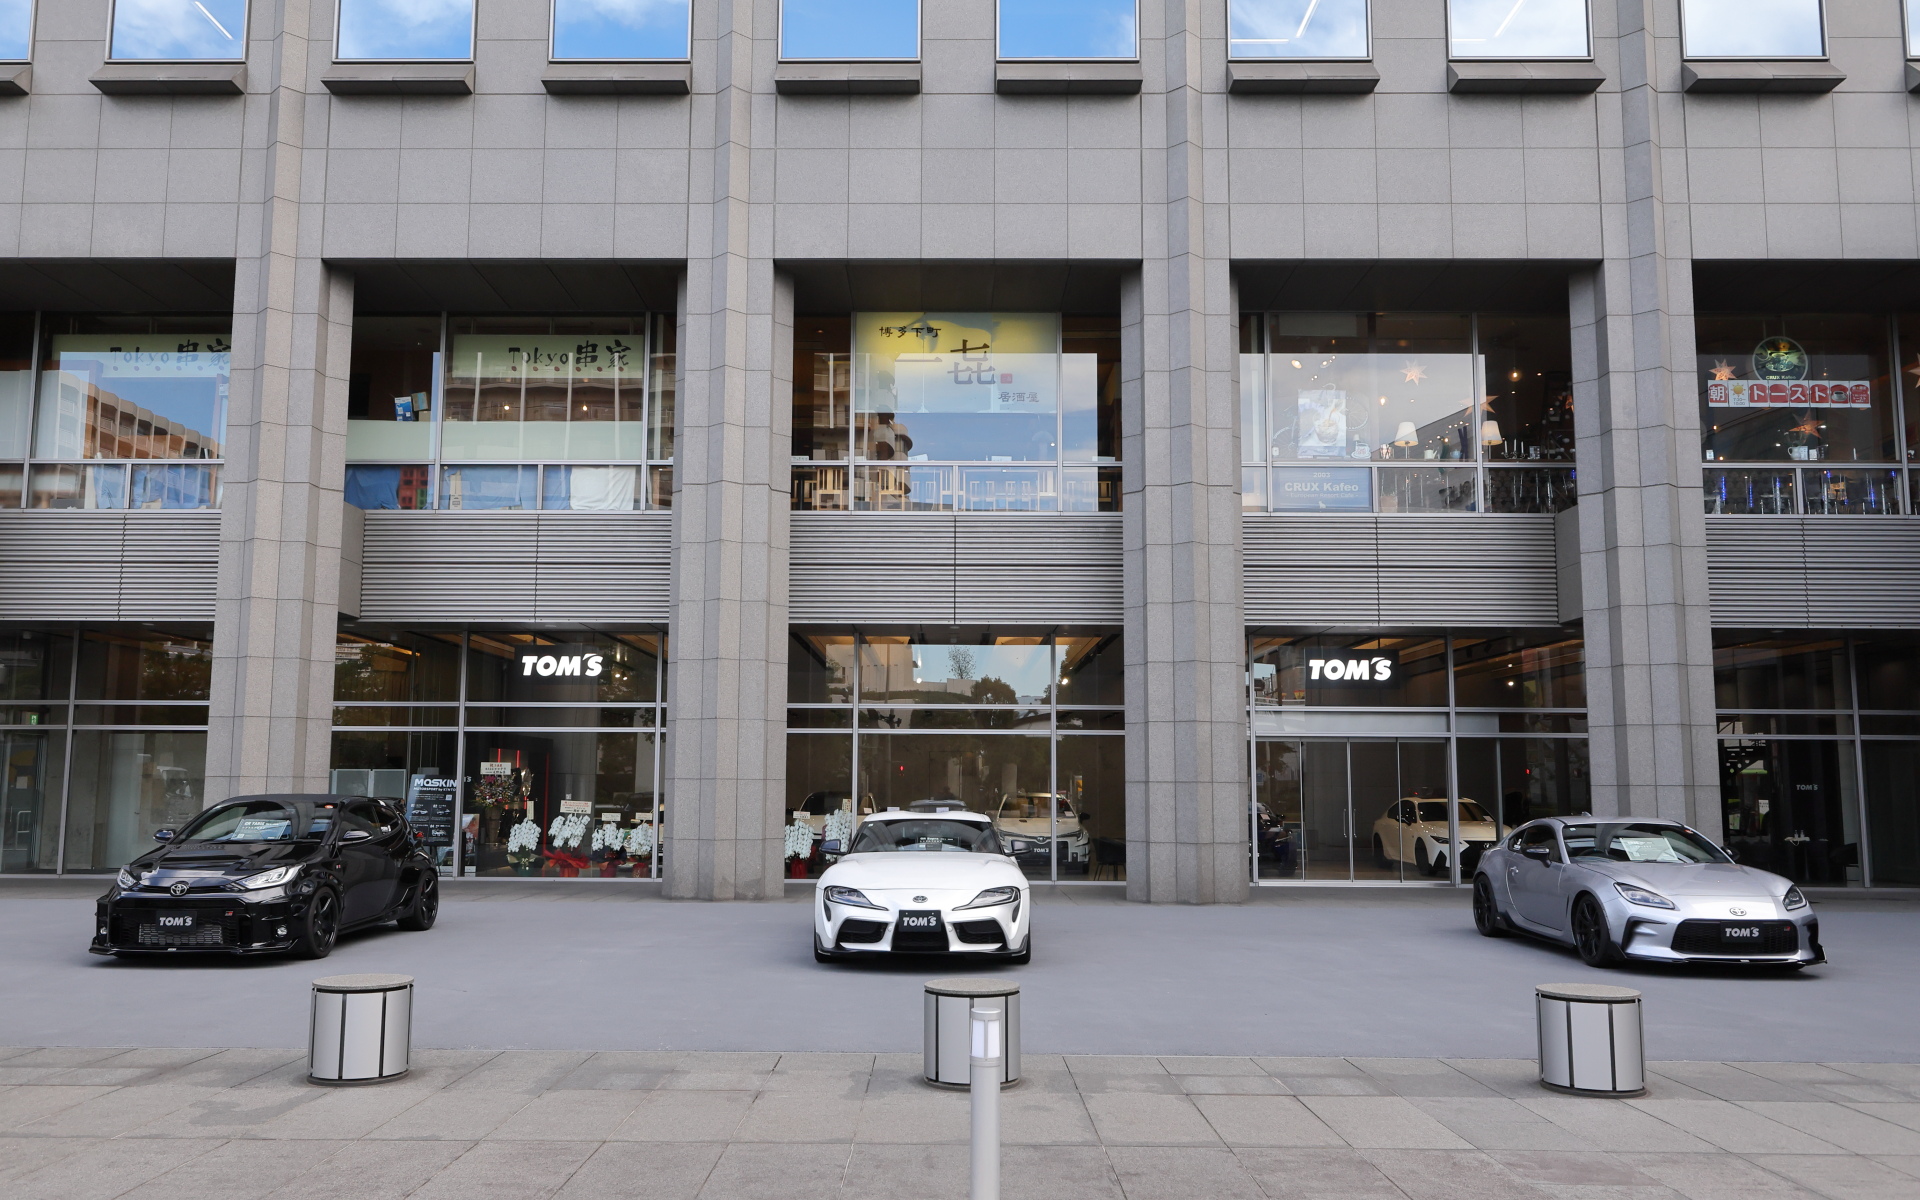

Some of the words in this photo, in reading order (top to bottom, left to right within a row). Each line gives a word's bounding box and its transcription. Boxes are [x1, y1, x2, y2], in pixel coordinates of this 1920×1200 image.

[878, 326, 942, 338] 博多下町
[998, 391, 1040, 402] 居酒屋
[1709, 386, 1725, 401] 朝
[1754, 385, 1826, 402] トースト
[1284, 482, 1320, 492] CRUX
[1323, 482, 1359, 492] Kafeo
[521, 653, 604, 677] TOM'S
[1308, 656, 1392, 681] TOM'S
[1796, 783, 1819, 791] TOM'S
[159, 915, 193, 927] TOM'S
[902, 915, 937, 927] TOM'S
[1724, 926, 1760, 938] TOM'S
